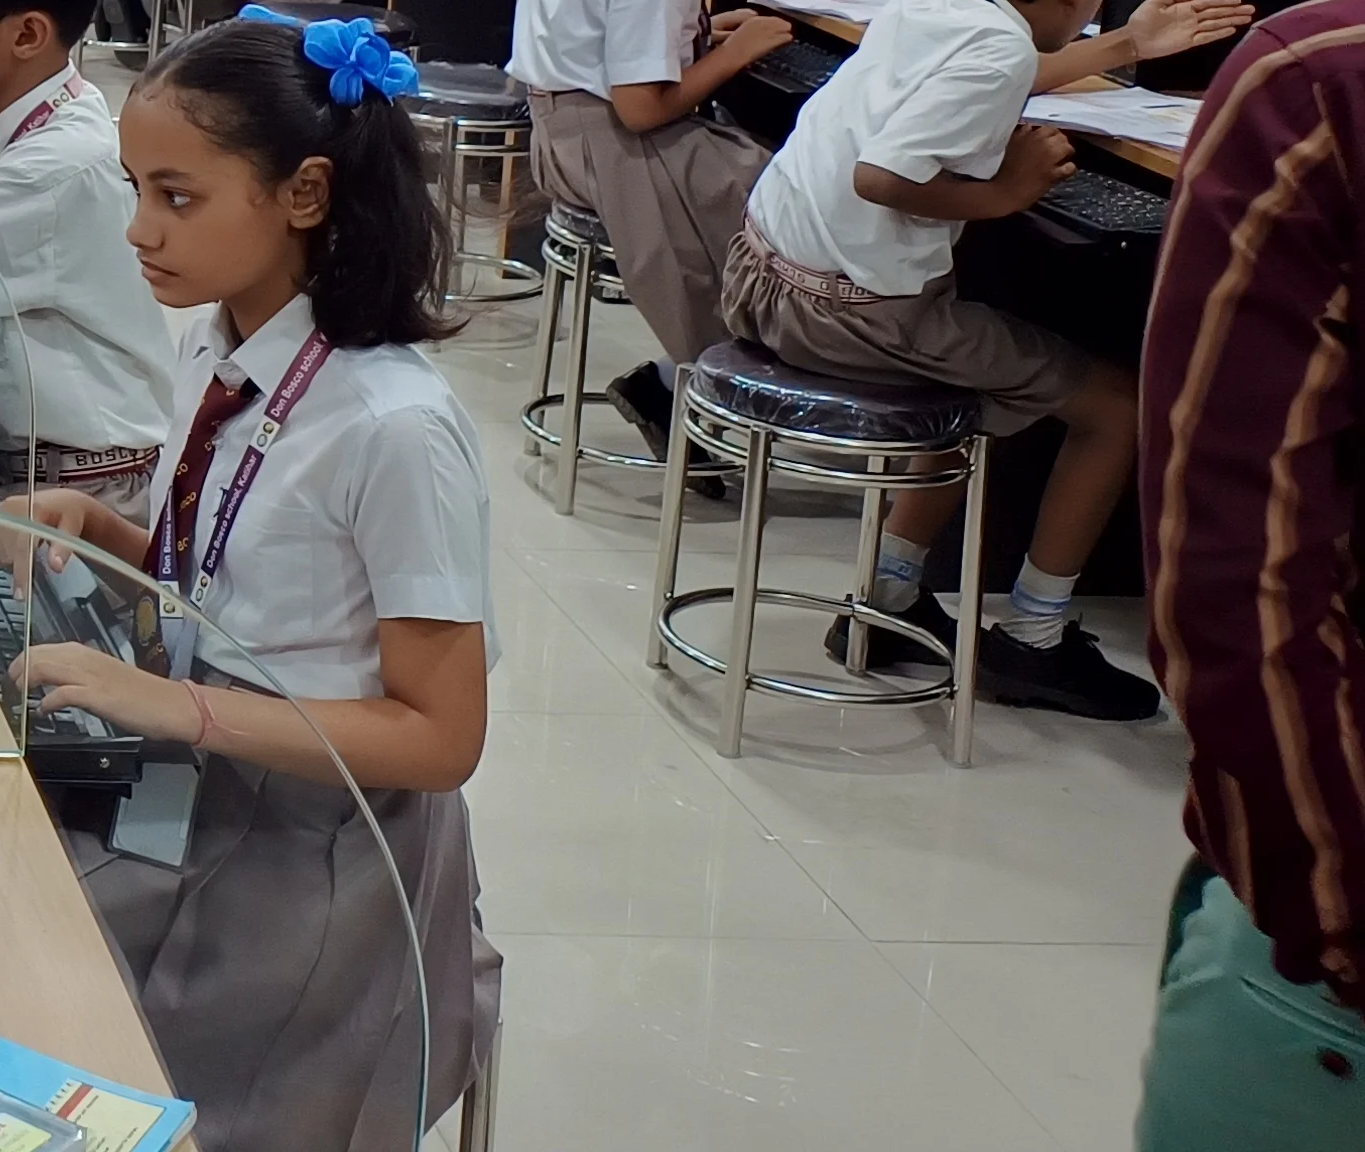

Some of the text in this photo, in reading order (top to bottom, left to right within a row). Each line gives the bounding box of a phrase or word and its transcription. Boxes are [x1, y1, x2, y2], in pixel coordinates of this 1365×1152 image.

[270, 399, 288, 419] Don
[281, 370, 305, 402] Bosco
[162, 553, 173, 575] Don
[206, 548, 218, 569] Don
[212, 518, 228, 550] Bosco
